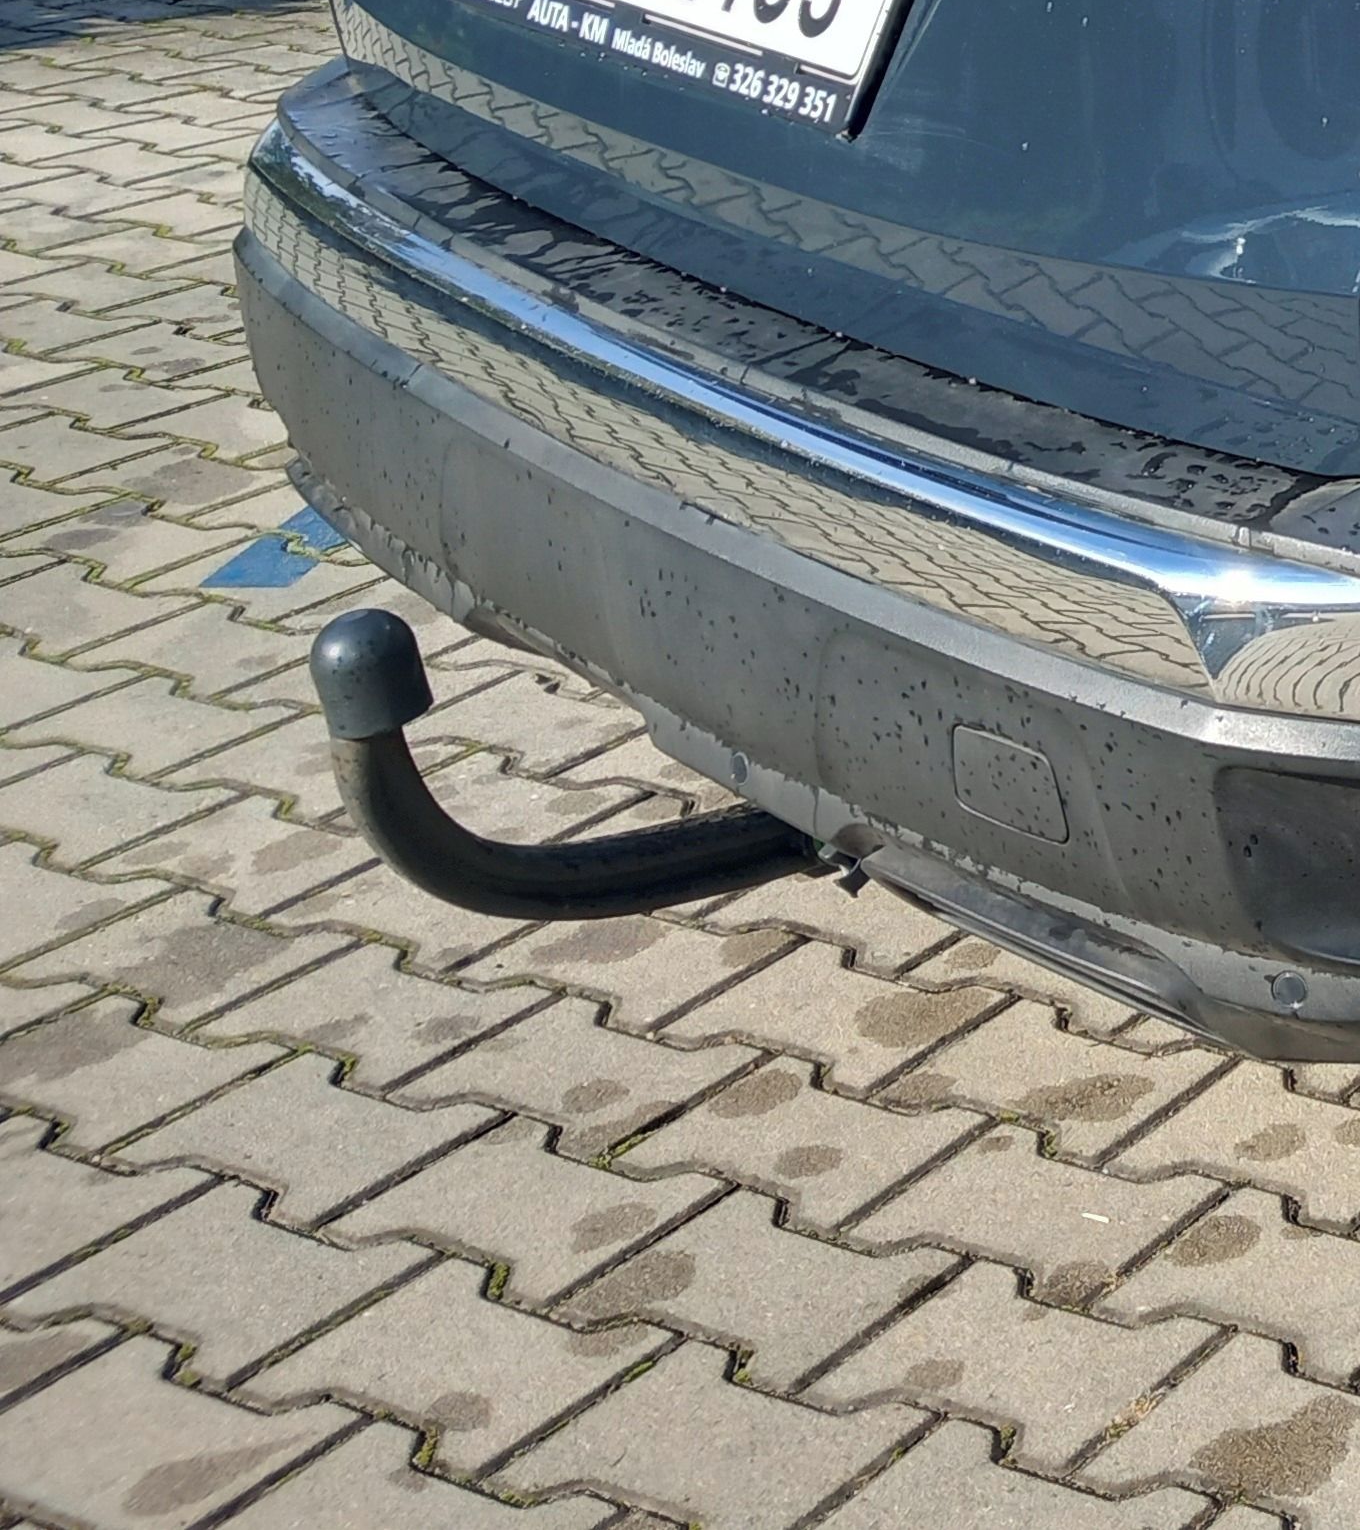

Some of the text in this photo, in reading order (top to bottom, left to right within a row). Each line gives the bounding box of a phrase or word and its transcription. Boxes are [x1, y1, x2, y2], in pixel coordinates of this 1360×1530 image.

[578, 11, 610, 45] KM
[611, 27, 652, 60] Mladá
[652, 41, 707, 79] Boleslav
[729, 62, 765, 98] 326
[762, 74, 801, 110] 329
[798, 86, 838, 123] 351
